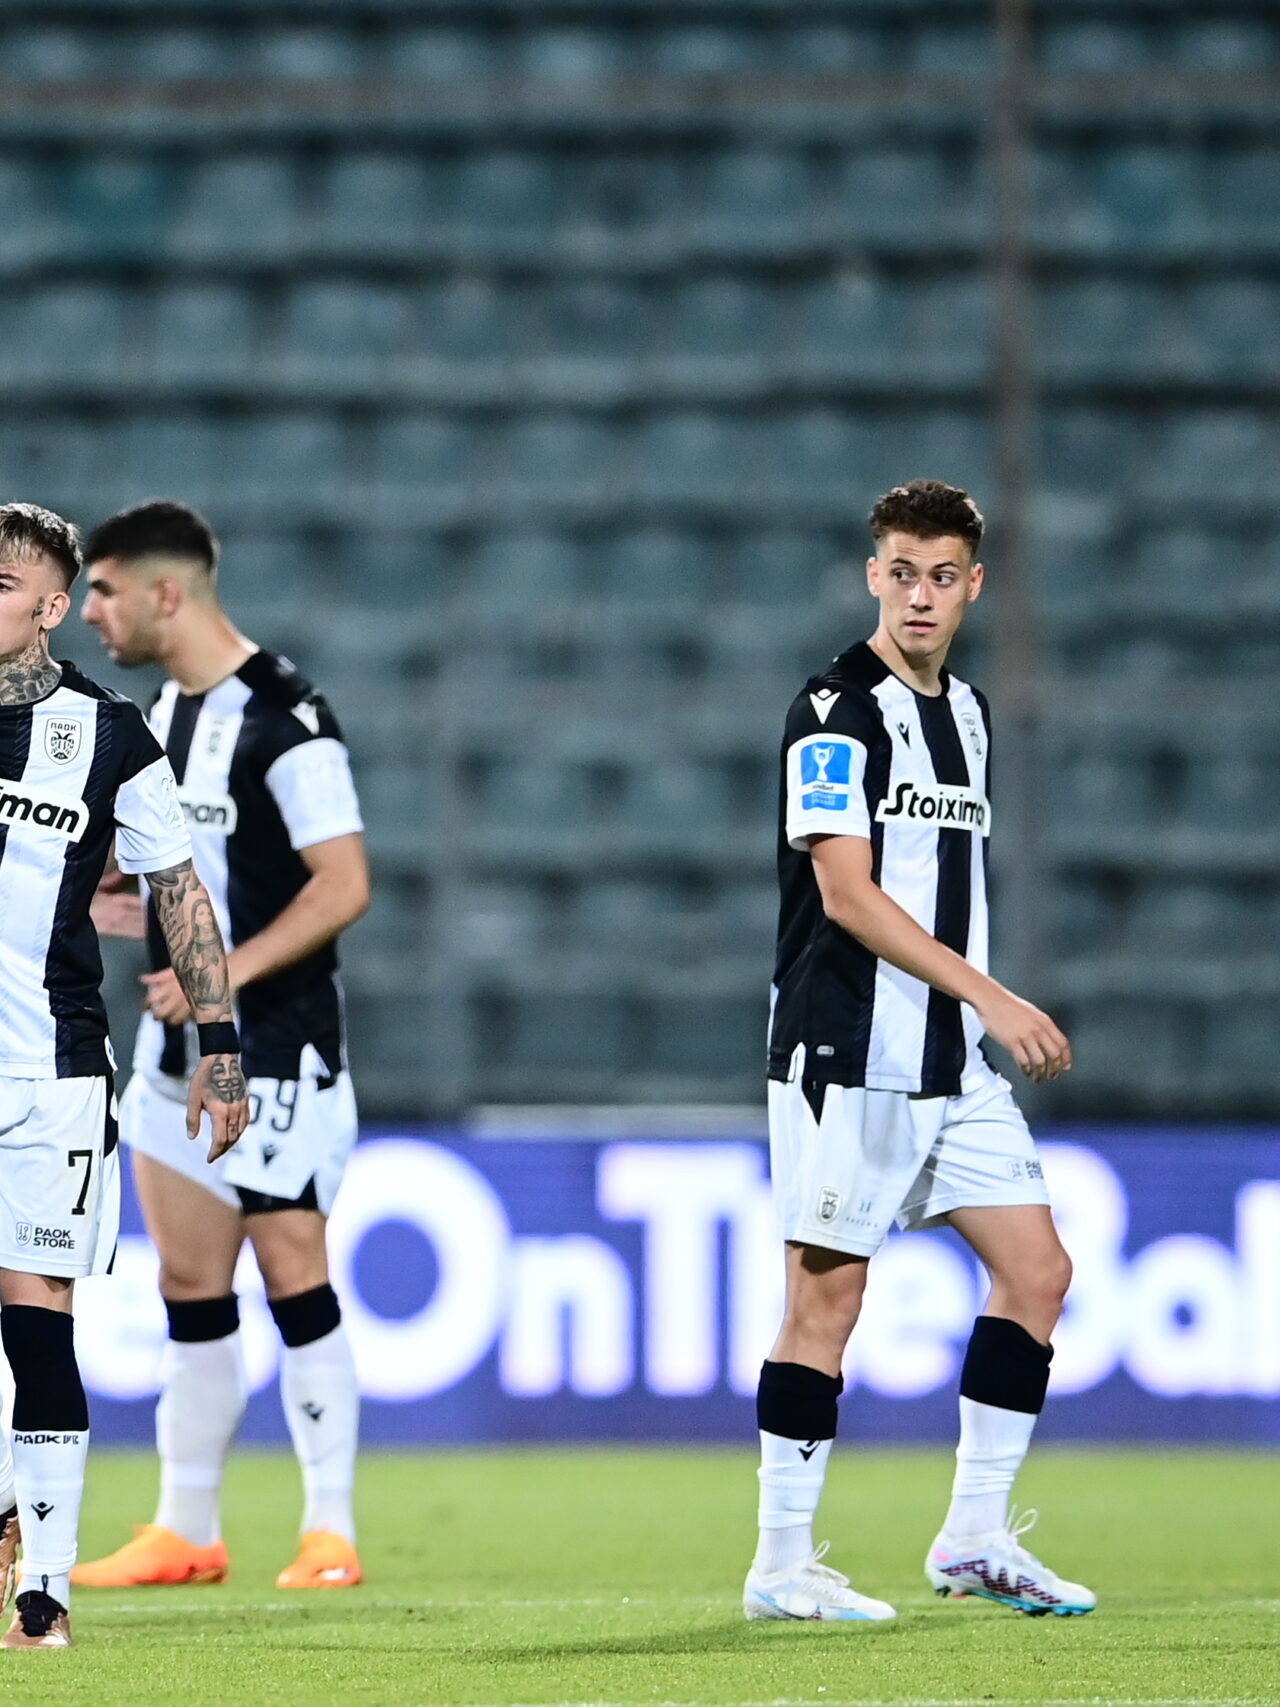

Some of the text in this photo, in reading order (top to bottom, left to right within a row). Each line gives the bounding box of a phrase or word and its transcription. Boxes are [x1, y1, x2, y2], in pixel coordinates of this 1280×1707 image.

[67, 1148, 93, 1215] 7
[34, 1227, 71, 1239] PAOK
[33, 1237, 76, 1250] STORE
[14, 1433, 61, 1445] PAOK
